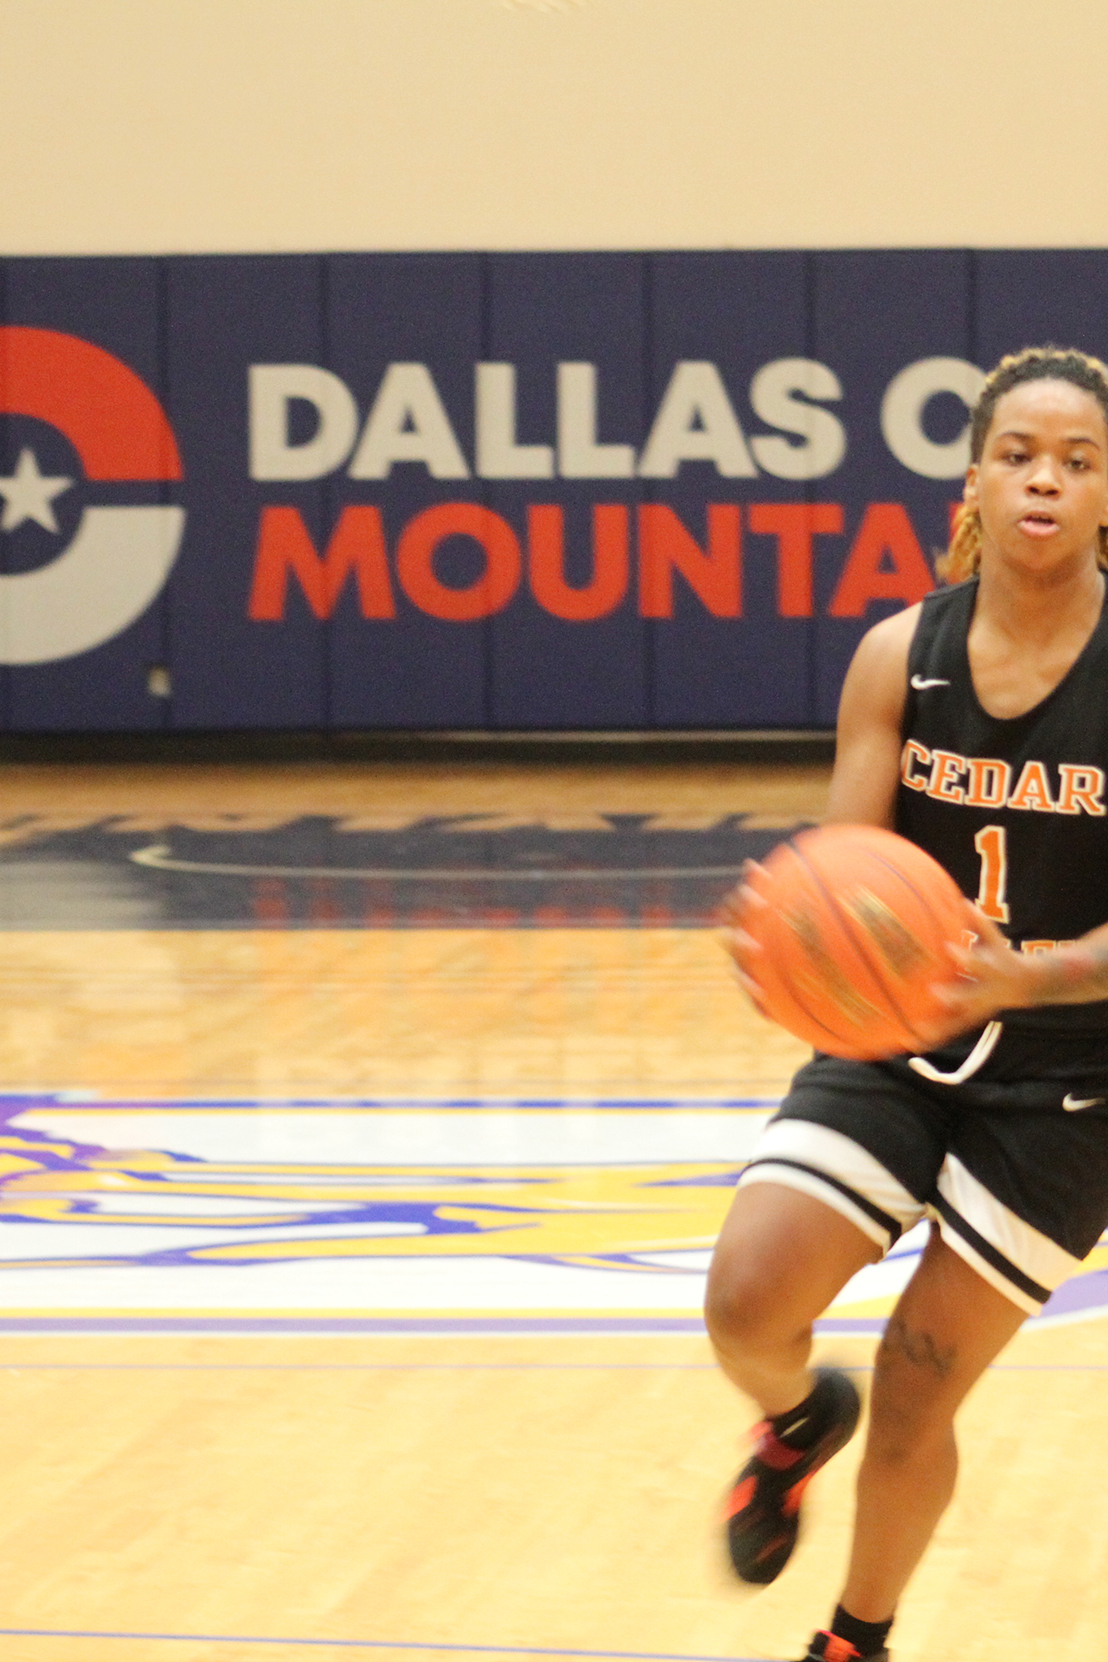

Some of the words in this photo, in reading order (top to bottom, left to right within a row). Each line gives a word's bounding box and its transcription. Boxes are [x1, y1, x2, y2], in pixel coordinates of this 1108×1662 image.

[248, 357, 847, 482] DALLAS
[248, 500, 962, 622] MOUNTA
[899, 738, 1107, 817] CEDAR
[974, 824, 1010, 925] 1
